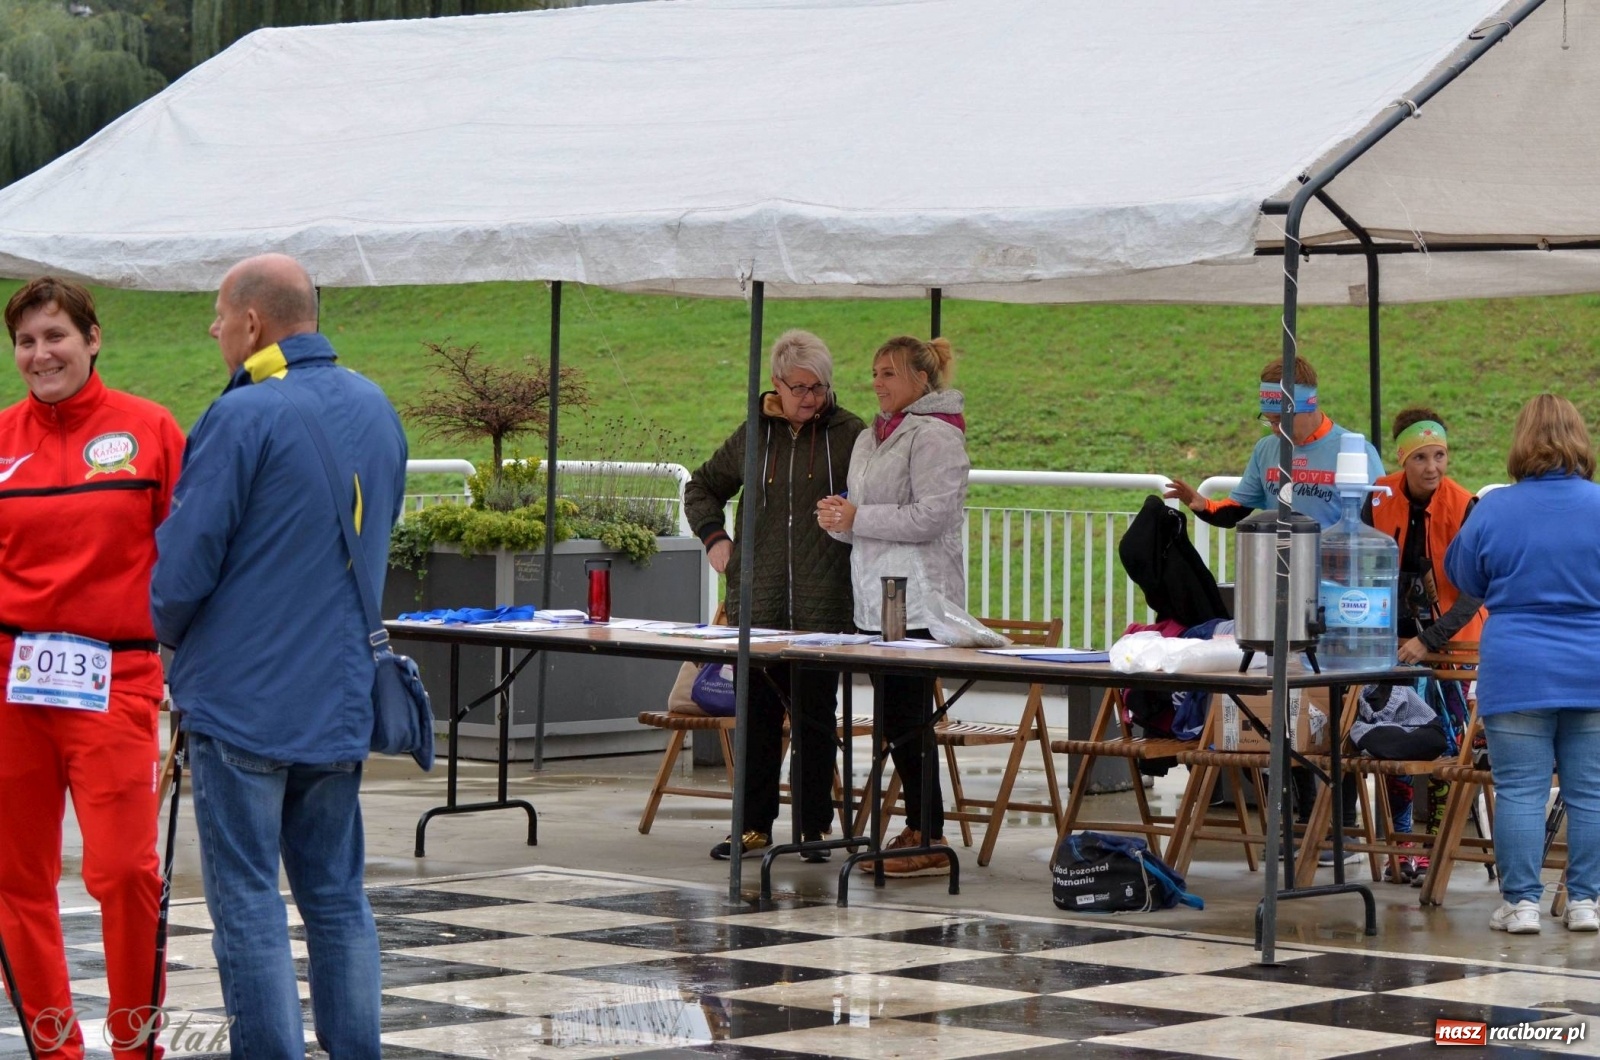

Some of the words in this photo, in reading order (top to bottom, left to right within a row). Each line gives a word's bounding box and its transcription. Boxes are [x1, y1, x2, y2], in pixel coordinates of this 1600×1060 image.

[1292, 471, 1332, 483] OVE
[1292, 481, 1333, 502] Walking
[37, 649, 87, 677] 013
[1069, 862, 1109, 877] pozostał
[1056, 876, 1095, 887] Poznaniu
